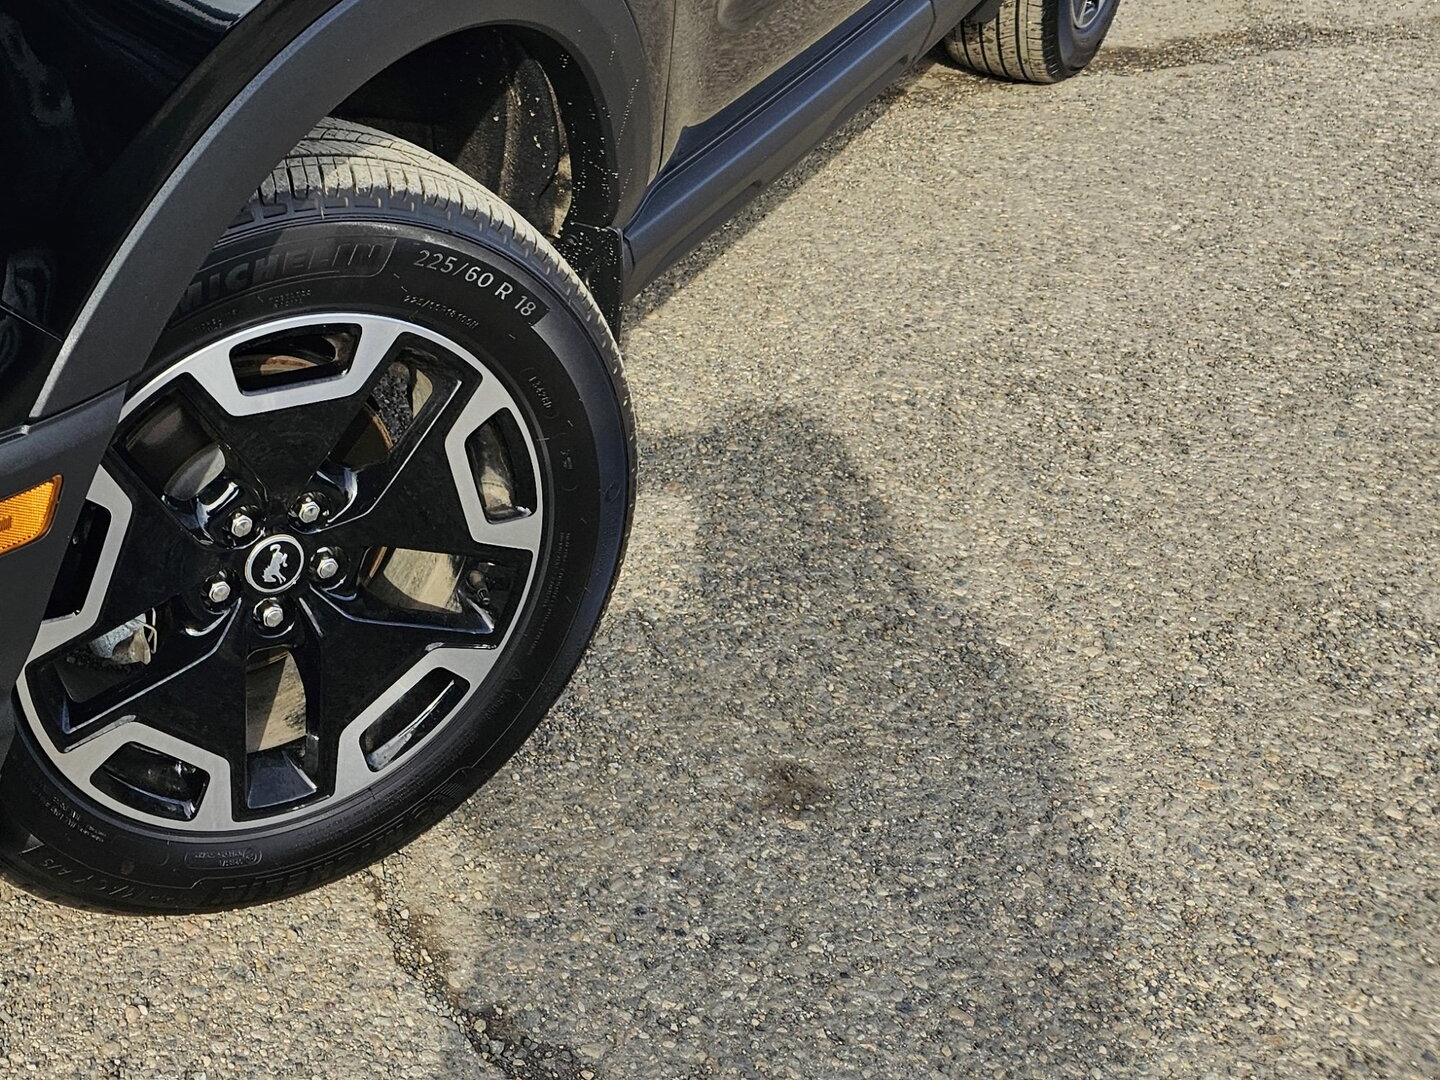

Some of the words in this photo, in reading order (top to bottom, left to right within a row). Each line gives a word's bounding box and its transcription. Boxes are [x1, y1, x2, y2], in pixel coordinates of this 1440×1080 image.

[414, 249, 493, 289] 225/60
[495, 280, 514, 302] R
[514, 295, 537, 318] 18
